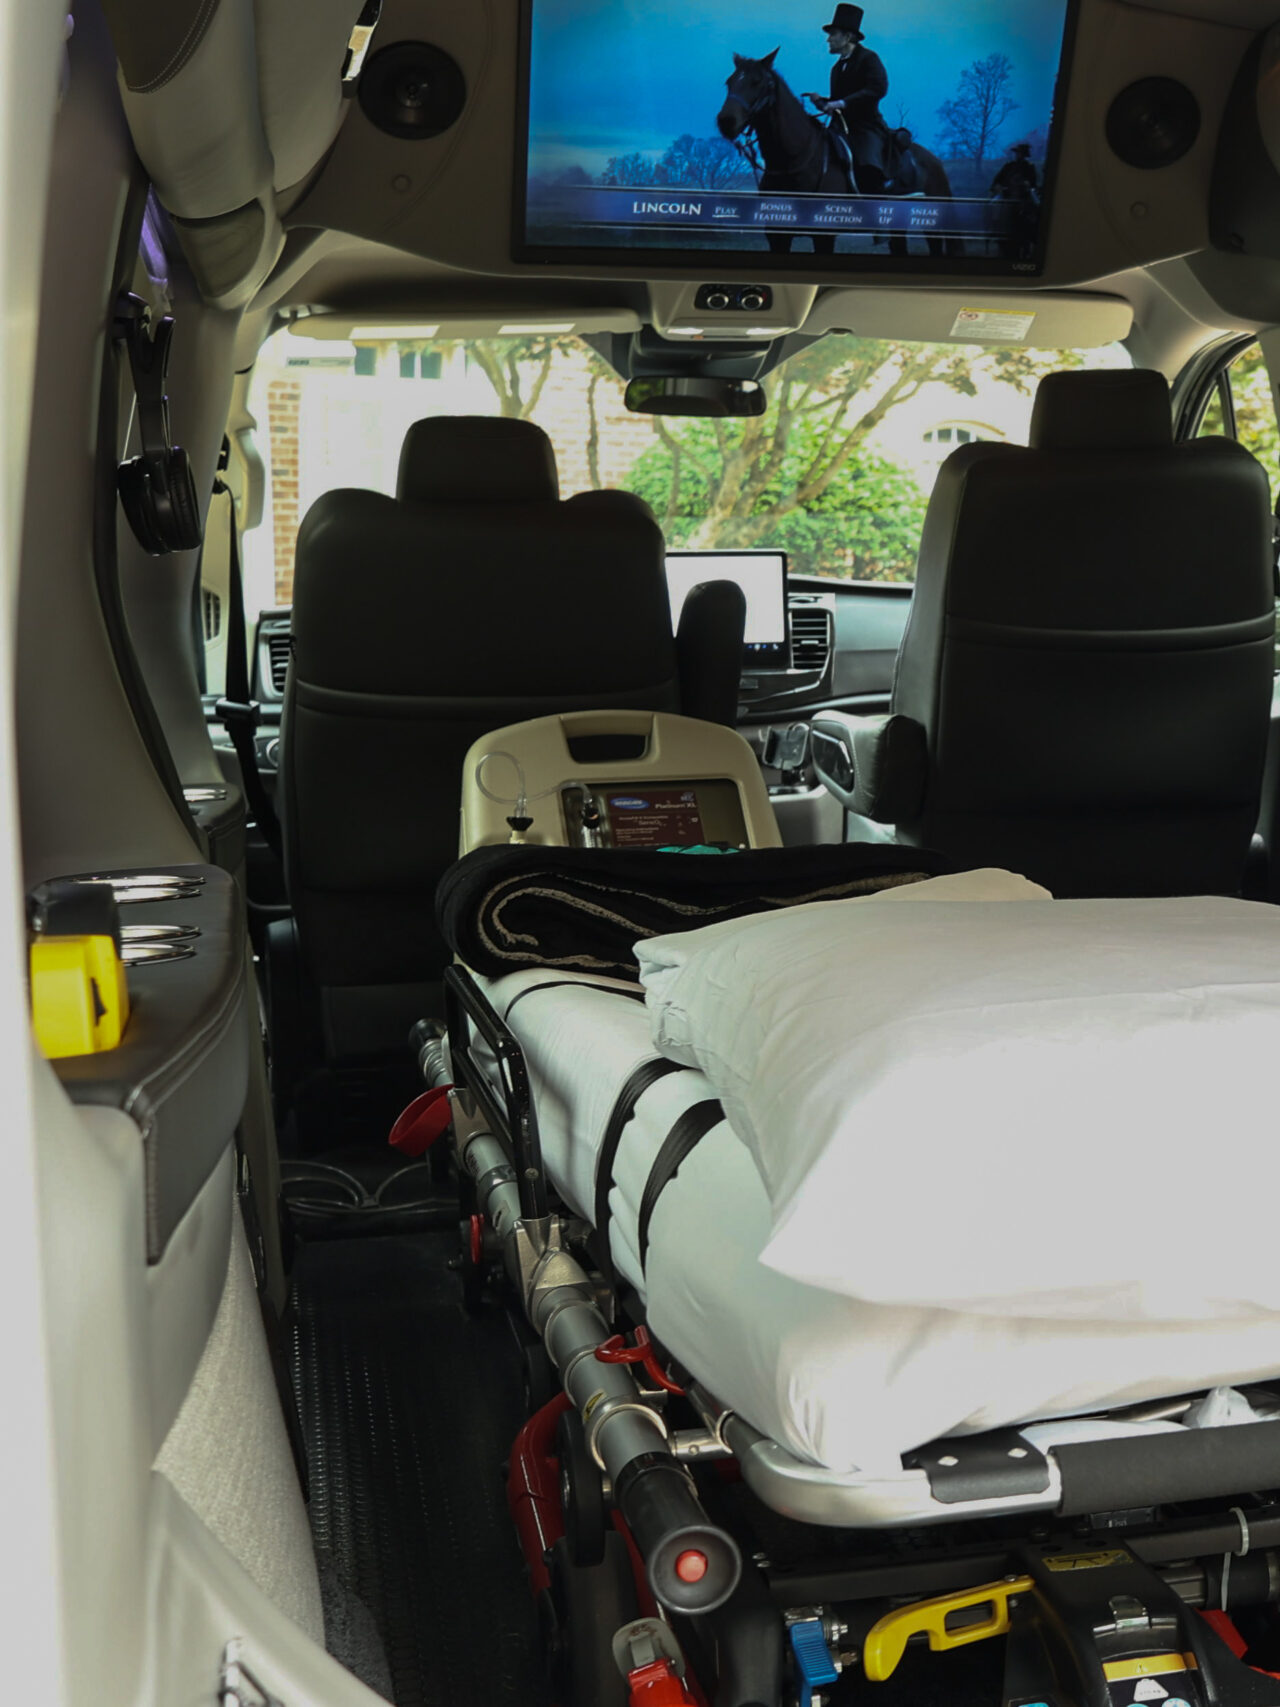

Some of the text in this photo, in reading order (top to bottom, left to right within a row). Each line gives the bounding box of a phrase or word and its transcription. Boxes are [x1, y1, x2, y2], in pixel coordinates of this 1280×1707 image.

[633, 201, 702, 216] LINCOLN
[715, 206, 738, 215] PLAY
[760, 202, 793, 212] BONUS
[824, 204, 853, 214] SCENE
[878, 206, 894, 215] SET
[910, 207, 939, 217] SNEAK
[753, 212, 798, 222] FEATURES
[813, 214, 863, 224] SELECTION
[878, 216, 893, 225] UP
[910, 217, 937, 226] PEEKS
